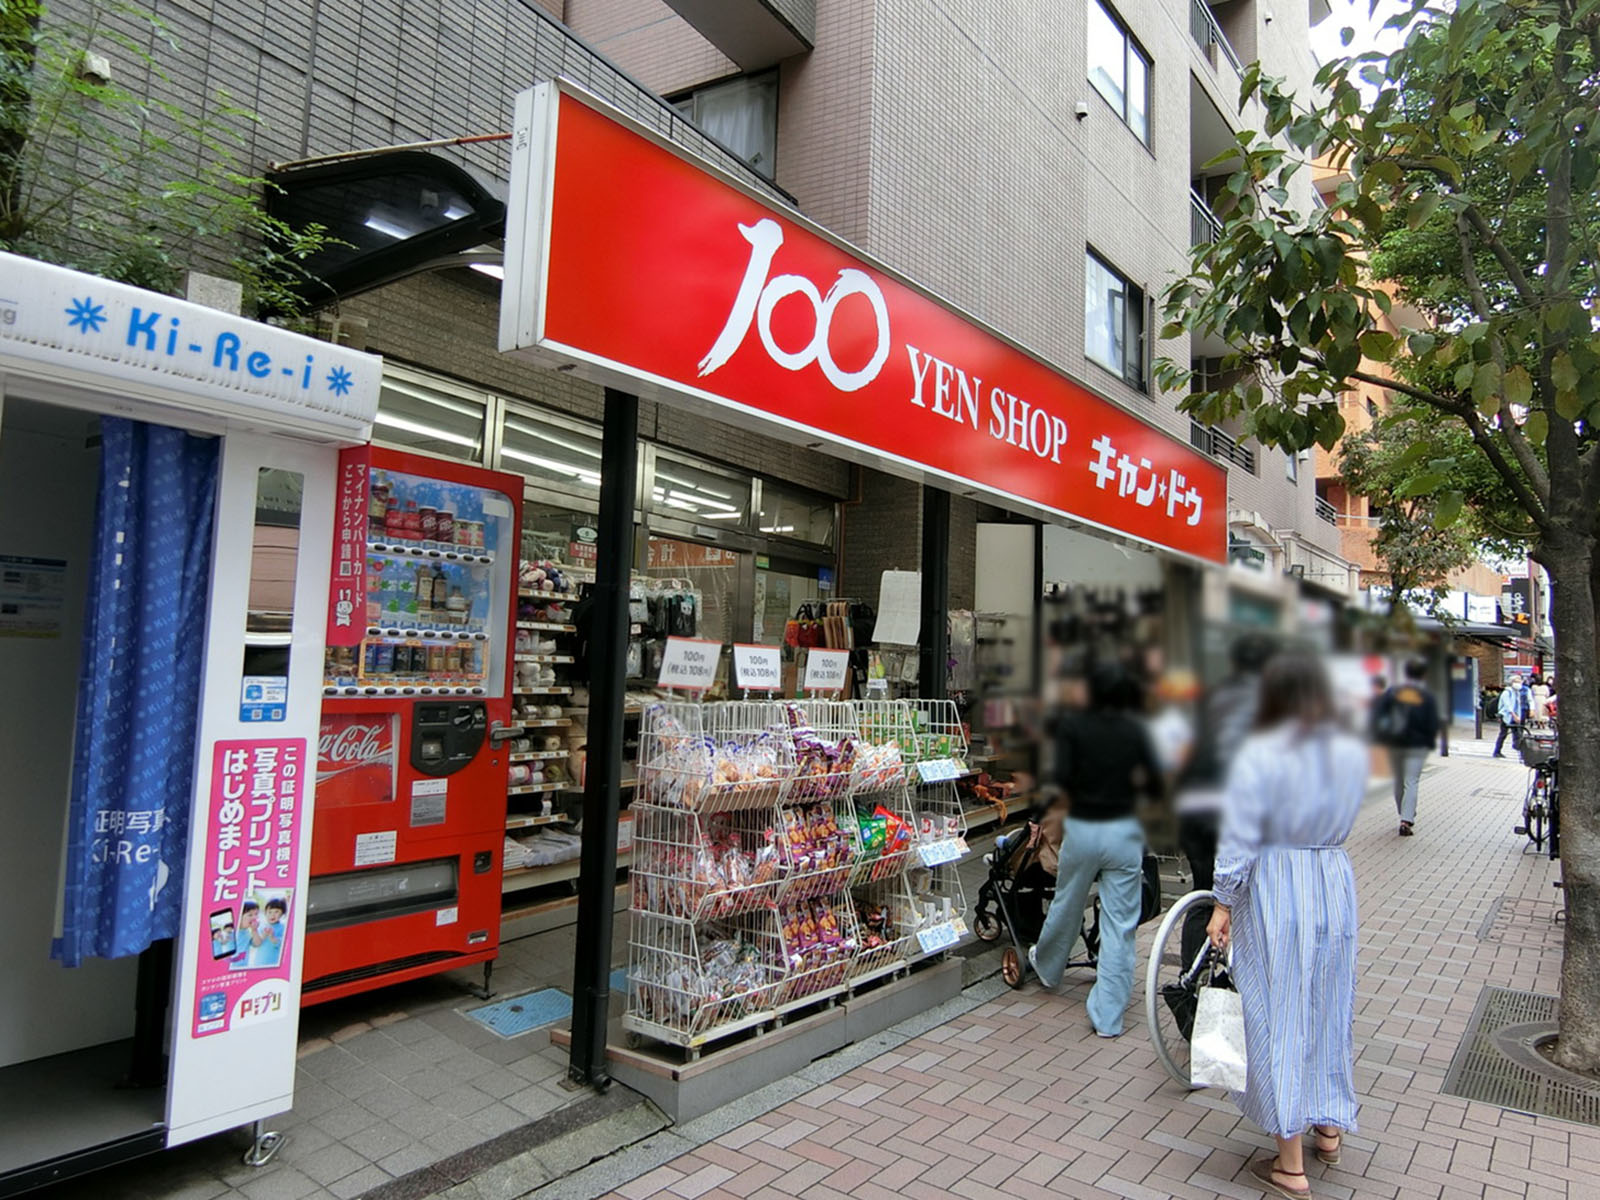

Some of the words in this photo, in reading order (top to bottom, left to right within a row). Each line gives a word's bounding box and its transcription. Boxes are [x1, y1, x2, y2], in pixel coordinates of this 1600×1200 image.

[126, 307, 314, 390] Ki-Re-i
[697, 218, 891, 393] 100
[905, 344, 982, 431] YEN
[989, 387, 1068, 465] SHOP
[352, 463, 367, 608] マイナンバーカード
[213, 749, 249, 902] はじめました
[246, 747, 279, 897] 写真プリント
[276, 747, 298, 878] この証明写真機で
